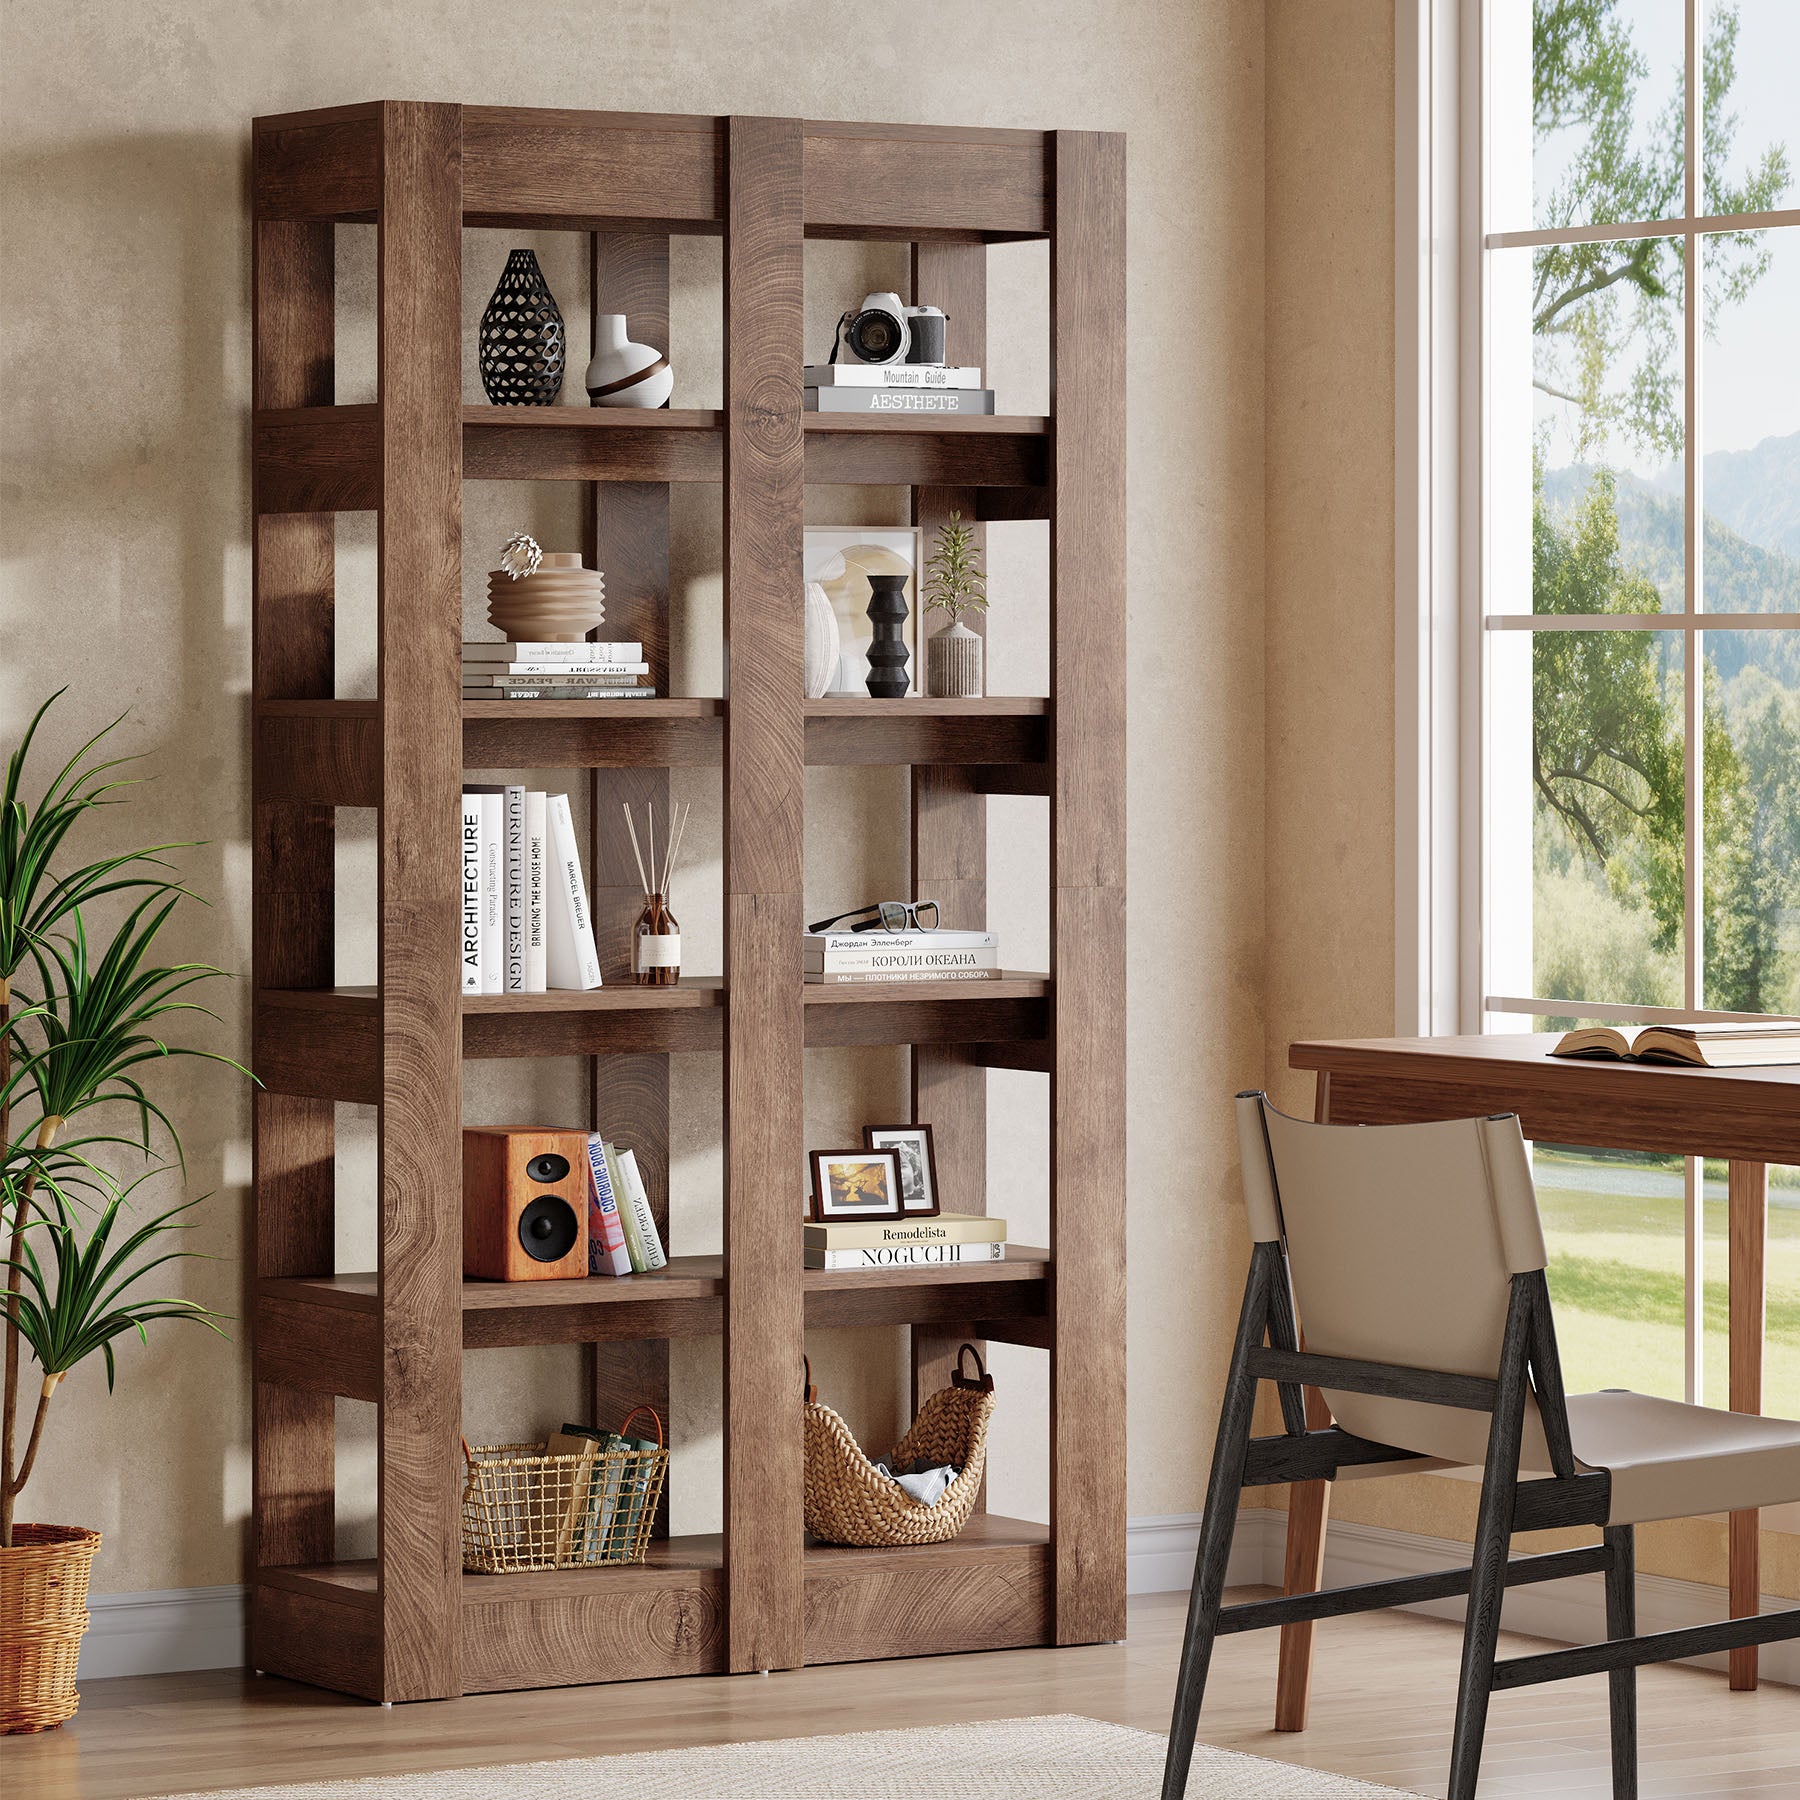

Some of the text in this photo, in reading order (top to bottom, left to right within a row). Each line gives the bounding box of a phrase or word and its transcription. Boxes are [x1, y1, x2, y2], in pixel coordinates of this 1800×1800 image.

[883, 370, 946, 384] Mountain Guide
[869, 393, 959, 410] AESTHETE
[487, 842, 497, 892] Constructing
[464, 814, 479, 967] ARCHITECTURE
[509, 790, 522, 990] FURNITURE DESIGN
[531, 836, 541, 947] BRINGING THE HOUSE HOME
[567, 861, 585, 930] MARCEL BREUER
[831, 939, 913, 948] Джордан Элленберг
[872, 955, 922, 967] КОРОЛИ
[925, 954, 976, 966] ОКЕАНА
[865, 973, 908, 982] ПЛОТНИКИ
[909, 972, 956, 980] НЕЗРИМОГО
[958, 970, 989, 979] СОБОРА
[882, 1227, 946, 1241] Remodelista
[861, 1245, 961, 1266] NOGUCHI
